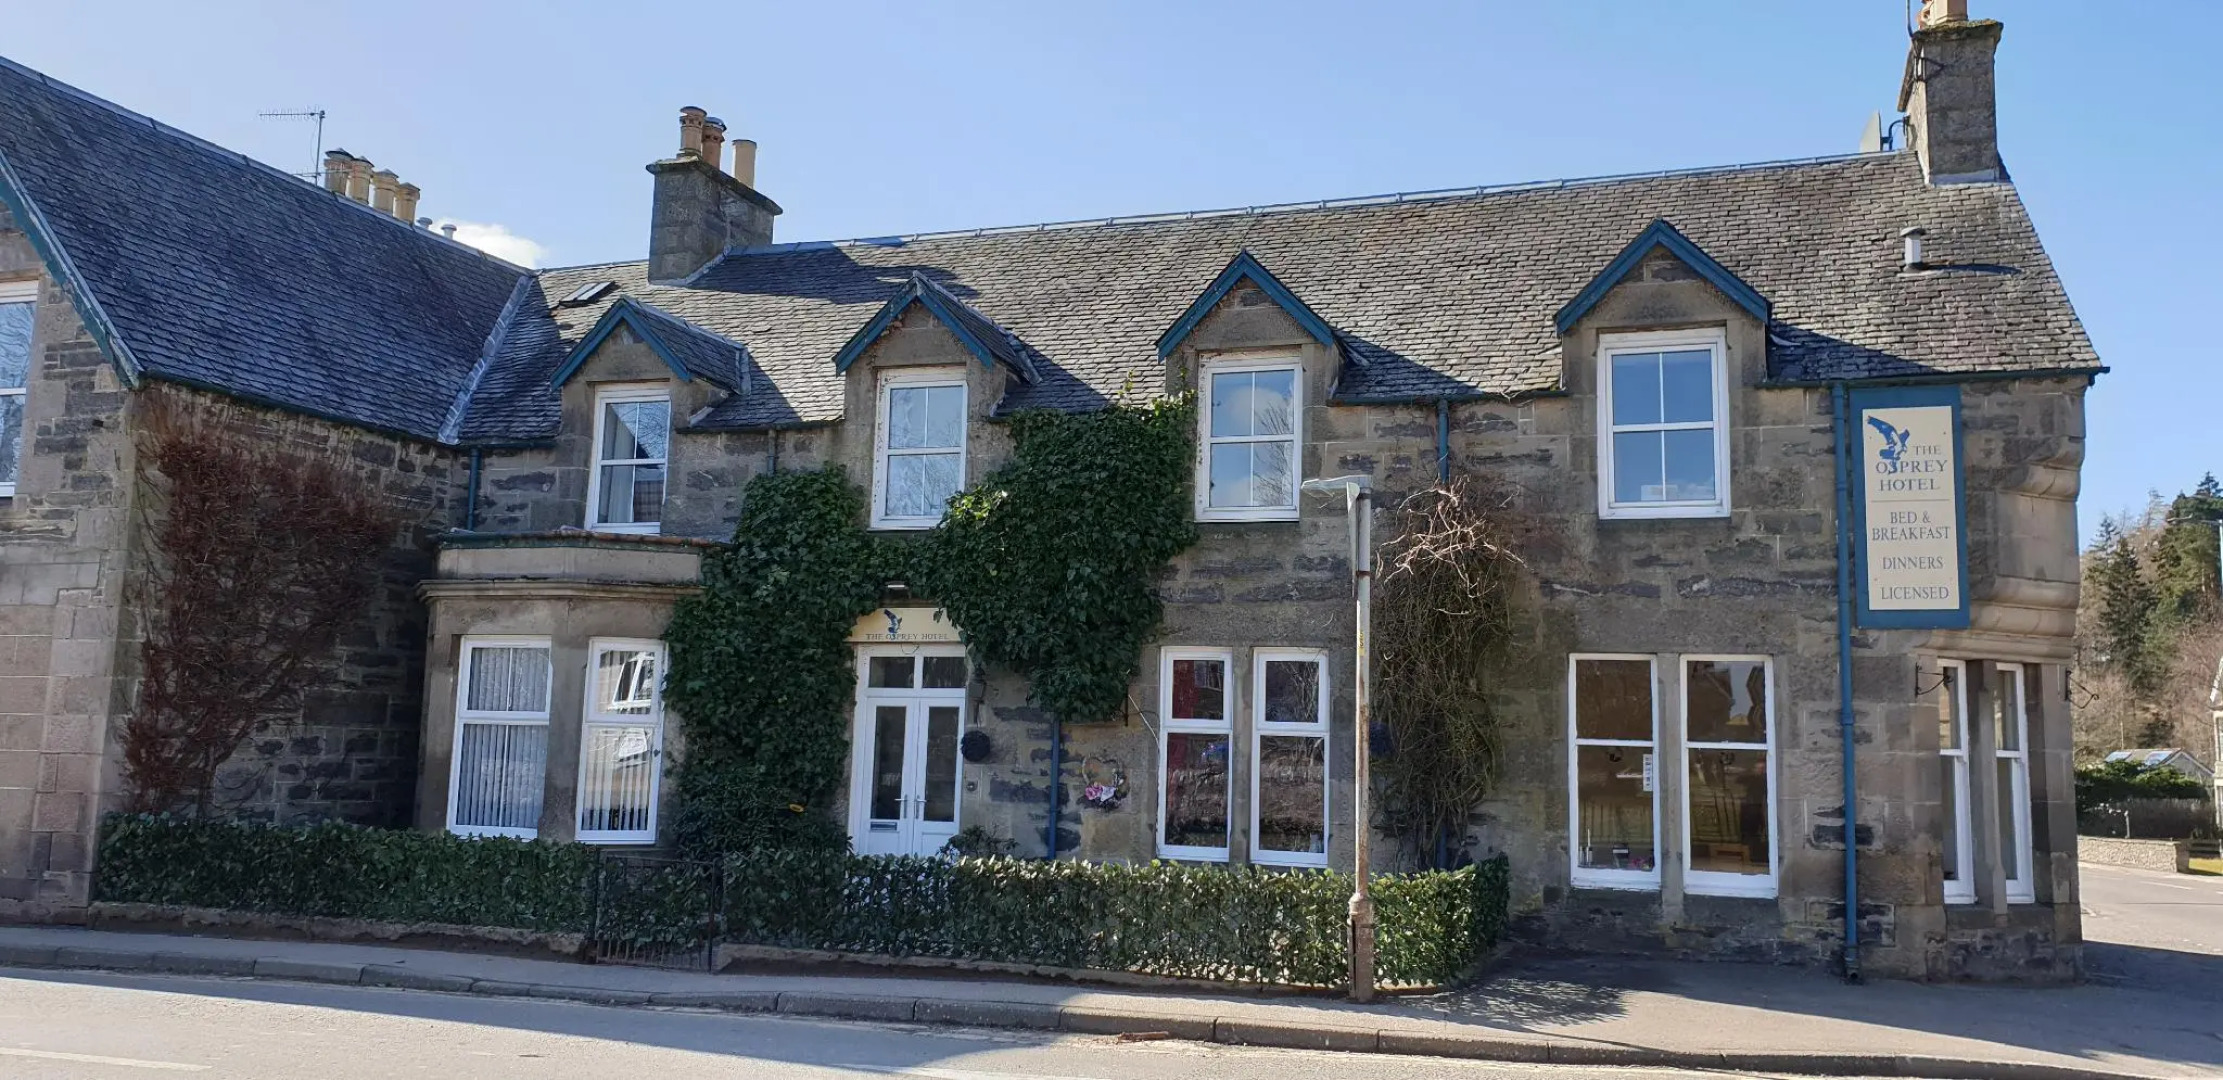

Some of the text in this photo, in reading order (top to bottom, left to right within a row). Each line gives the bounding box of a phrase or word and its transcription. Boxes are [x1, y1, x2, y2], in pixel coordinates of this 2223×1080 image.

[1912, 445, 1942, 456] THE
[1875, 459, 1949, 475] OSPREY
[1879, 478, 1941, 492] HOTEL
[1890, 510, 1932, 524] BED &
[1872, 526, 1951, 541] BREAKFAST
[1882, 556, 1944, 570] DINNERS
[1881, 586, 1950, 600] LICENSED
